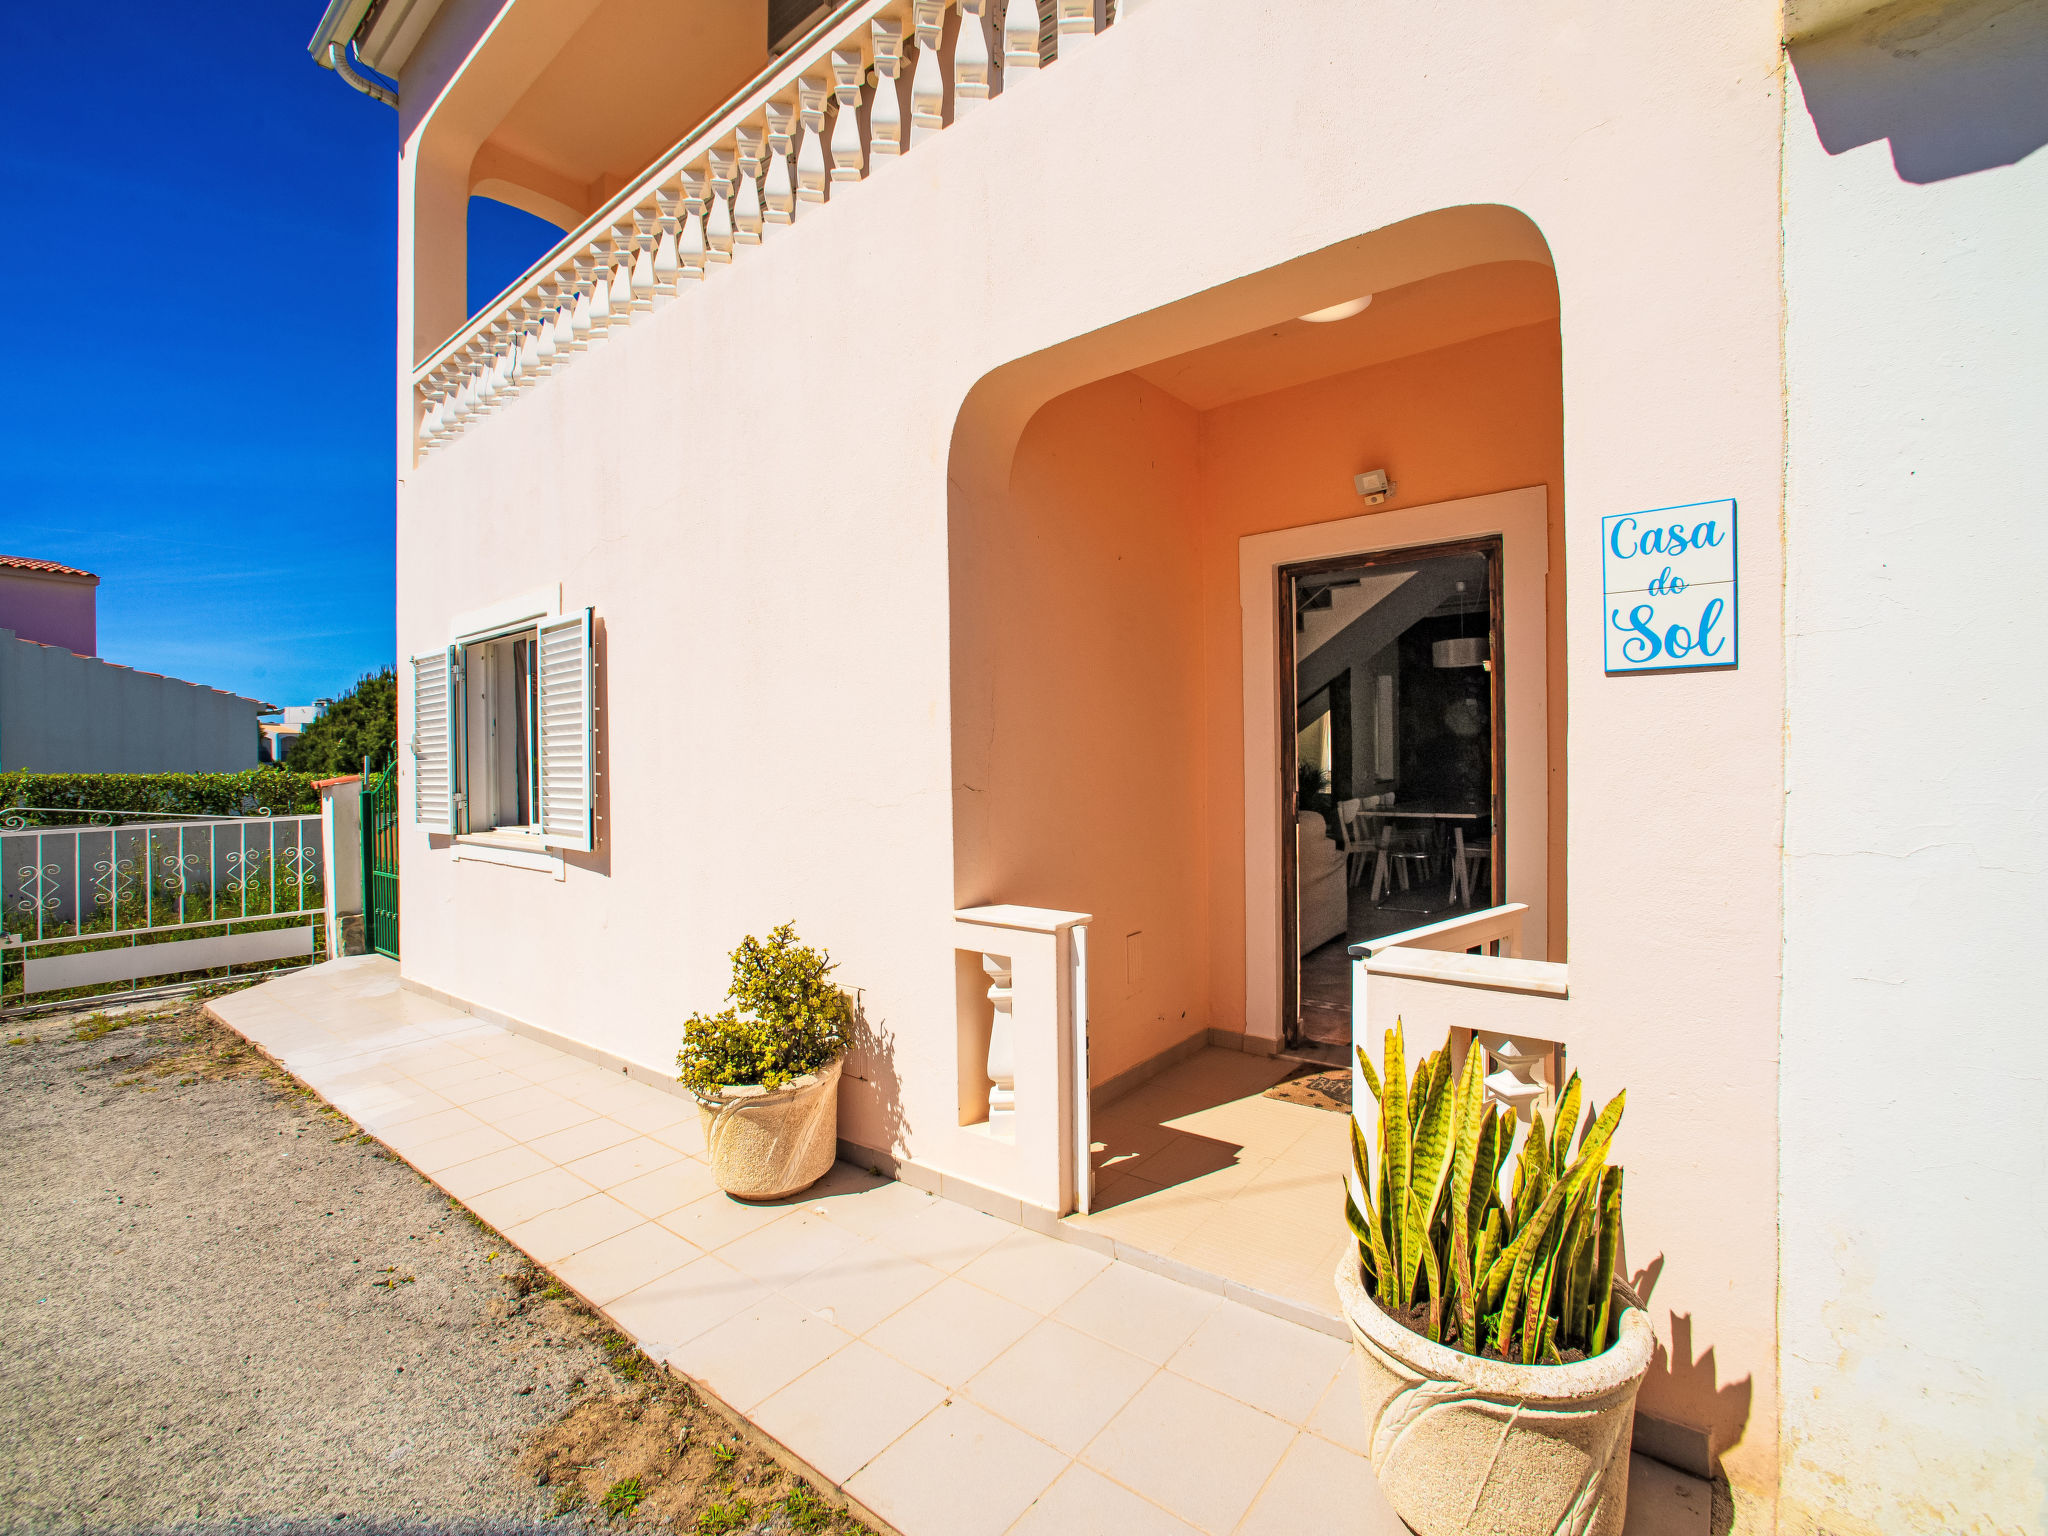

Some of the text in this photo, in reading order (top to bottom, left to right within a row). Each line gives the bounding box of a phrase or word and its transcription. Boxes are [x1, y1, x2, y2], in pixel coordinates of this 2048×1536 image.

[1610, 517, 1726, 560] Casa
[1648, 566, 1690, 597] do
[1611, 597, 1726, 663] Sol
